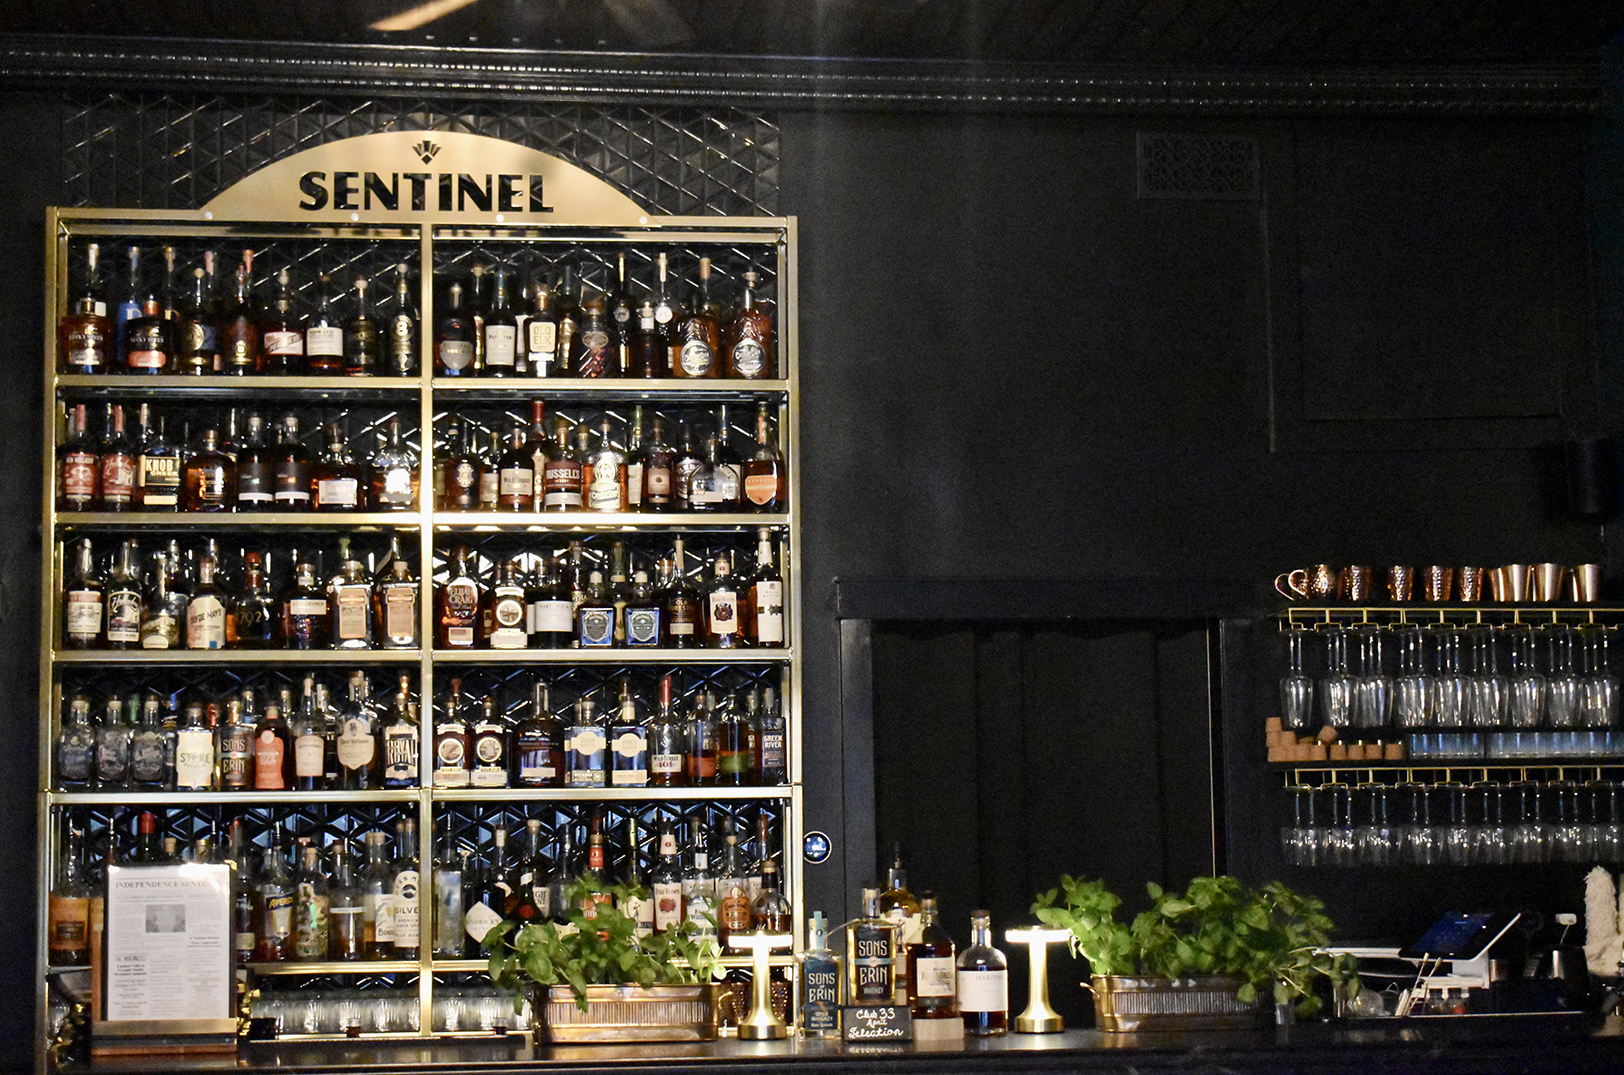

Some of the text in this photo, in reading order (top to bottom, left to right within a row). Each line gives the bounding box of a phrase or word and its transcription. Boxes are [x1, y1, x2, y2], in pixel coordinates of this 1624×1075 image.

[299, 171, 554, 213] SENTINEL
[533, 336, 551, 345] ELK
[146, 459, 173, 471] KNOB
[546, 468, 581, 480] RUSSELL'S
[450, 587, 473, 595] ELIJAH
[448, 595, 473, 605] CRAIG
[239, 611, 262, 627] 792
[222, 739, 246, 752] SONS
[223, 759, 245, 774] ERIN
[116, 881, 177, 889] INDEPENDENCE
[858, 940, 888, 956] SONS
[808, 973, 835, 985] SONS
[860, 967, 888, 986] ERIN
[809, 988, 835, 1003] ERIN
[856, 1008, 896, 1020] Club 33
[866, 1019, 887, 1028] April
[848, 1026, 904, 1038] Selection
